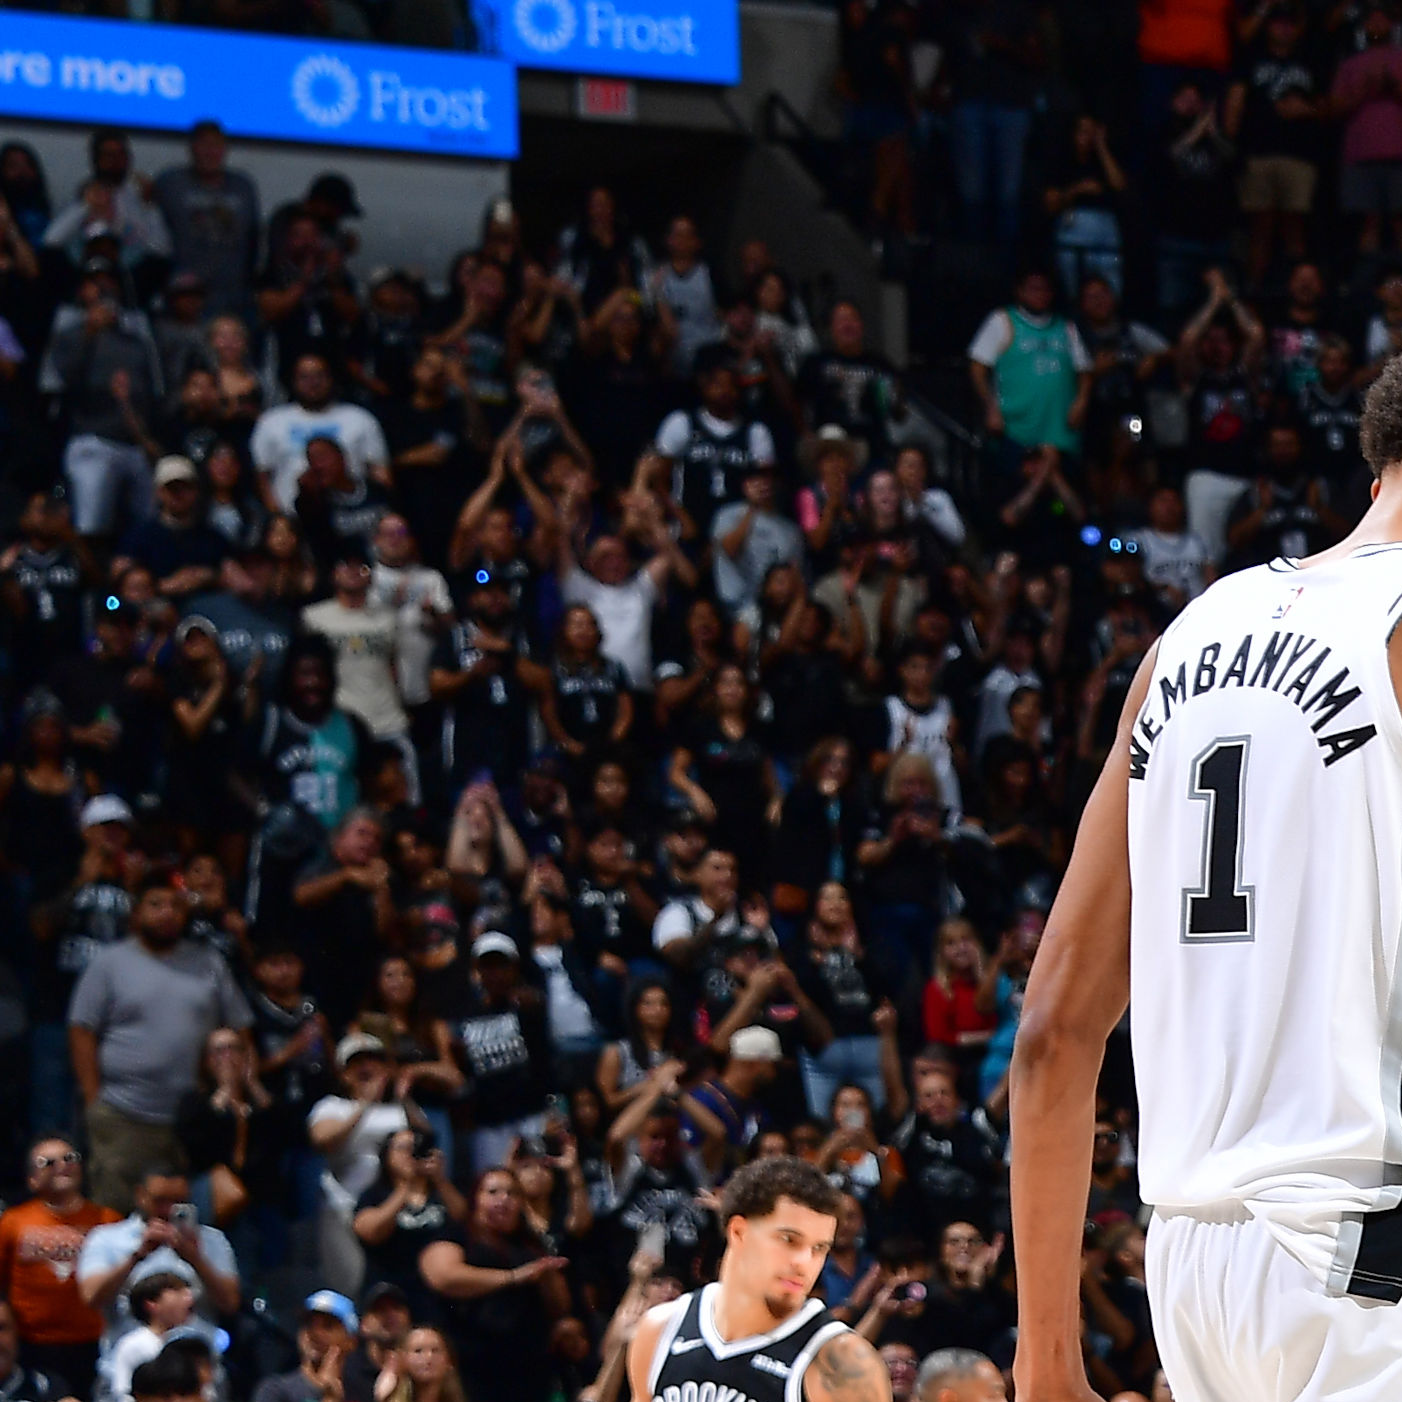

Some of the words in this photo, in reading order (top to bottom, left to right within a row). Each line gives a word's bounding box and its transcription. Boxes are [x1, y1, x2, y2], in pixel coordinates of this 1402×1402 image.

[587, 2, 698, 56] Frost
[61, 56, 186, 100] more
[368, 70, 490, 131] Frost
[1127, 631, 1378, 781] WEMBANYAMA
[1180, 734, 1255, 943] 1
